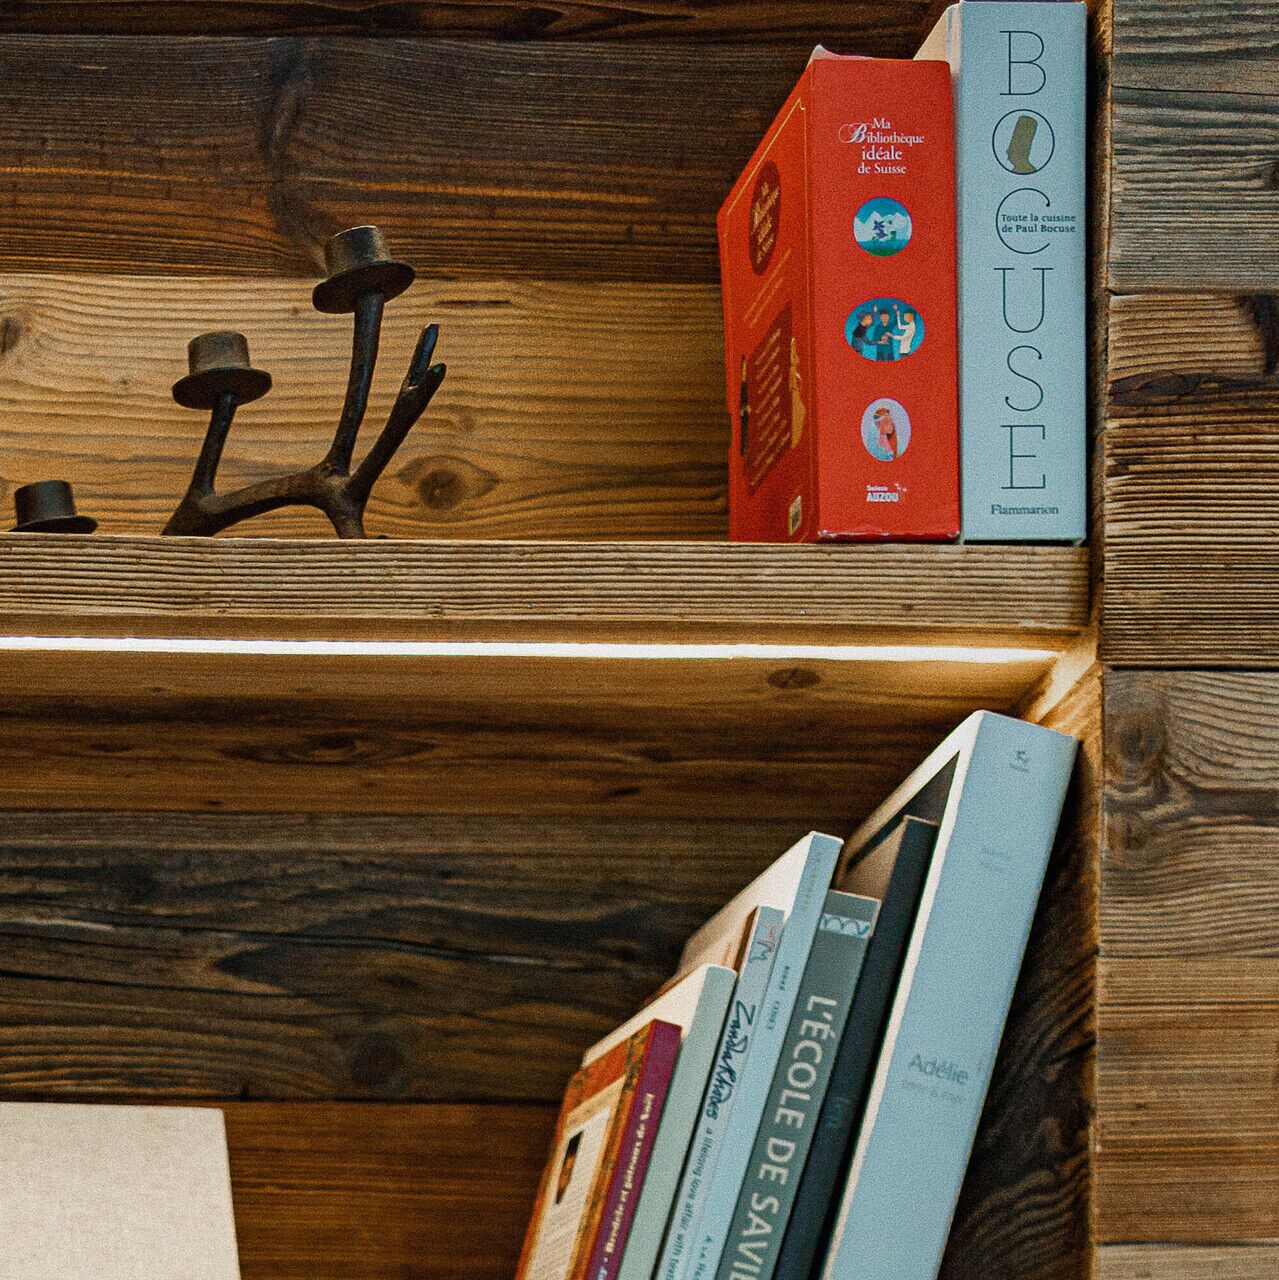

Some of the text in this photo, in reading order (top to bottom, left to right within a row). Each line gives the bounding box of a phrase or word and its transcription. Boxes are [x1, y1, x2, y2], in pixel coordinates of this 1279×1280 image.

[872, 117, 891, 129] Ma
[838, 123, 925, 147] Bibliothèque
[862, 146, 902, 160] idéale
[857, 162, 907, 174] de Suisse
[1002, 213, 1076, 222] Toute la cuisine
[1002, 224, 1076, 233] de Paul Bocuse
[992, 31, 1054, 490] BOCUSE
[990, 504, 1059, 515] Flammarion
[775, 995, 838, 1129] L'ÉCOLE
[758, 1139, 796, 1186] DE
